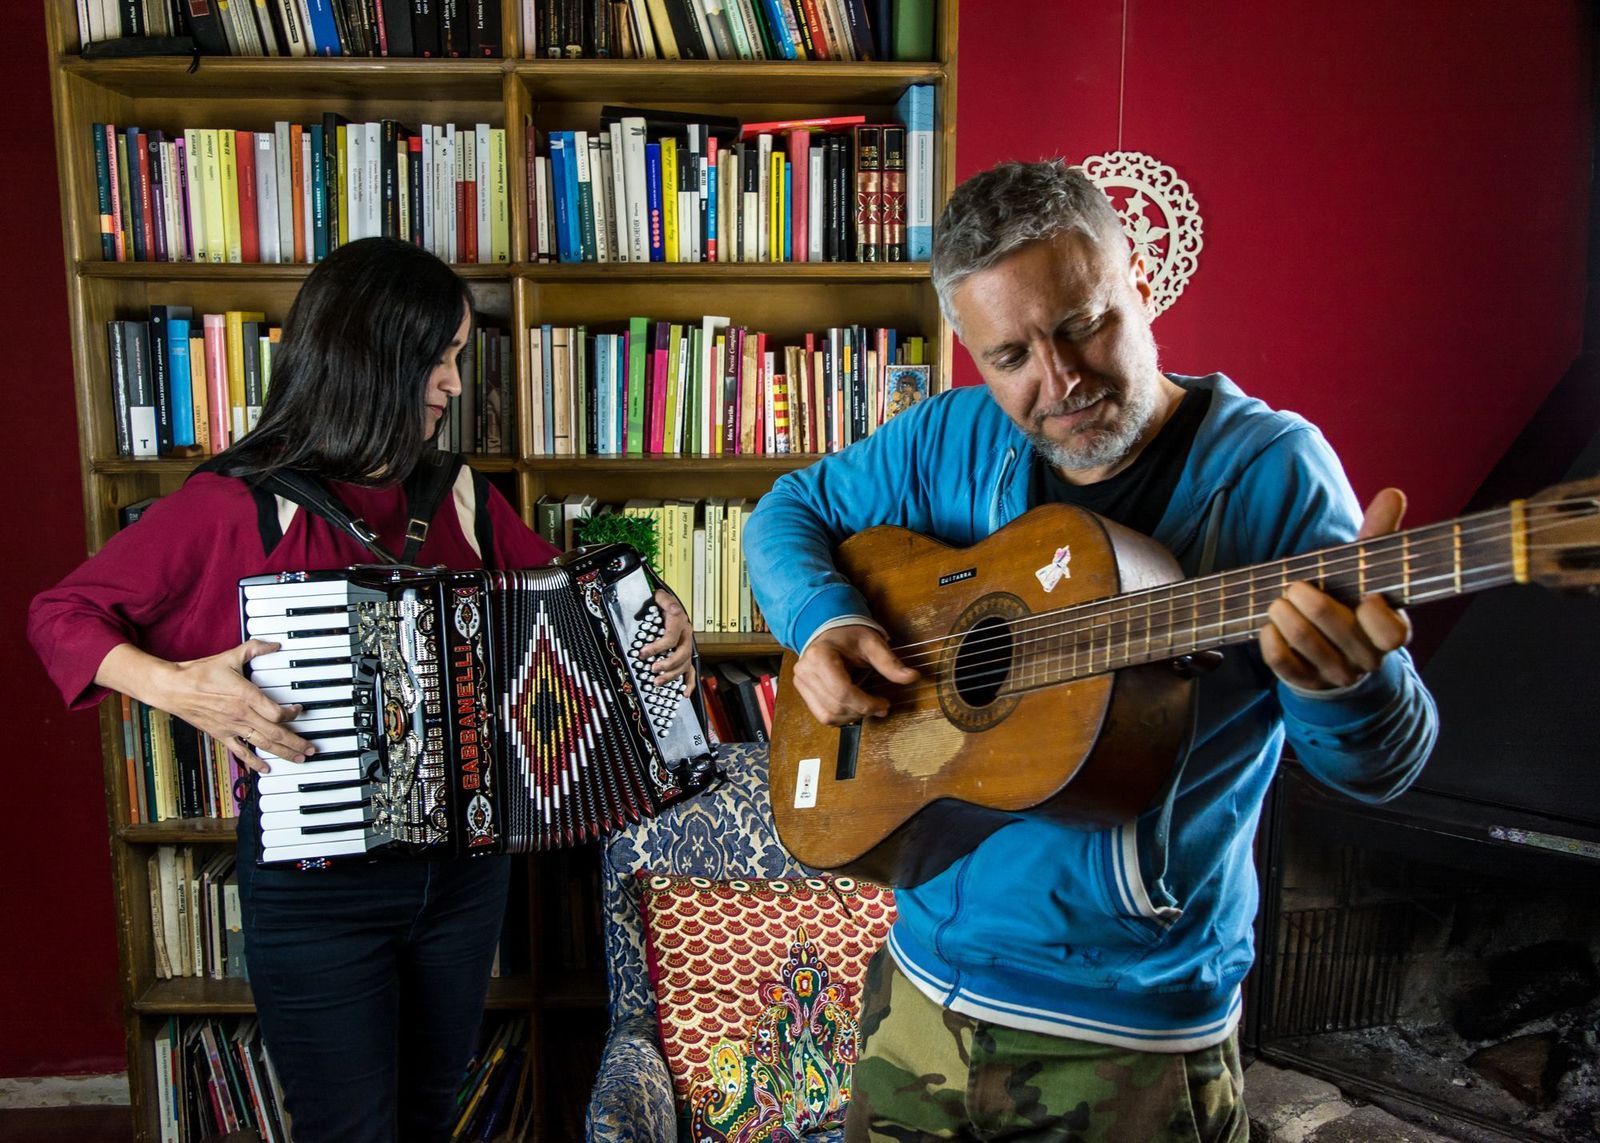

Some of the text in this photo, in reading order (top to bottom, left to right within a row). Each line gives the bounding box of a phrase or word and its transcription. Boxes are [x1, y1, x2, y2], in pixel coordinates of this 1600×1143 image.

[477, 21, 483, 29] La
[141, 439, 149, 449] T
[454, 644, 480, 790] GABBANELLI
